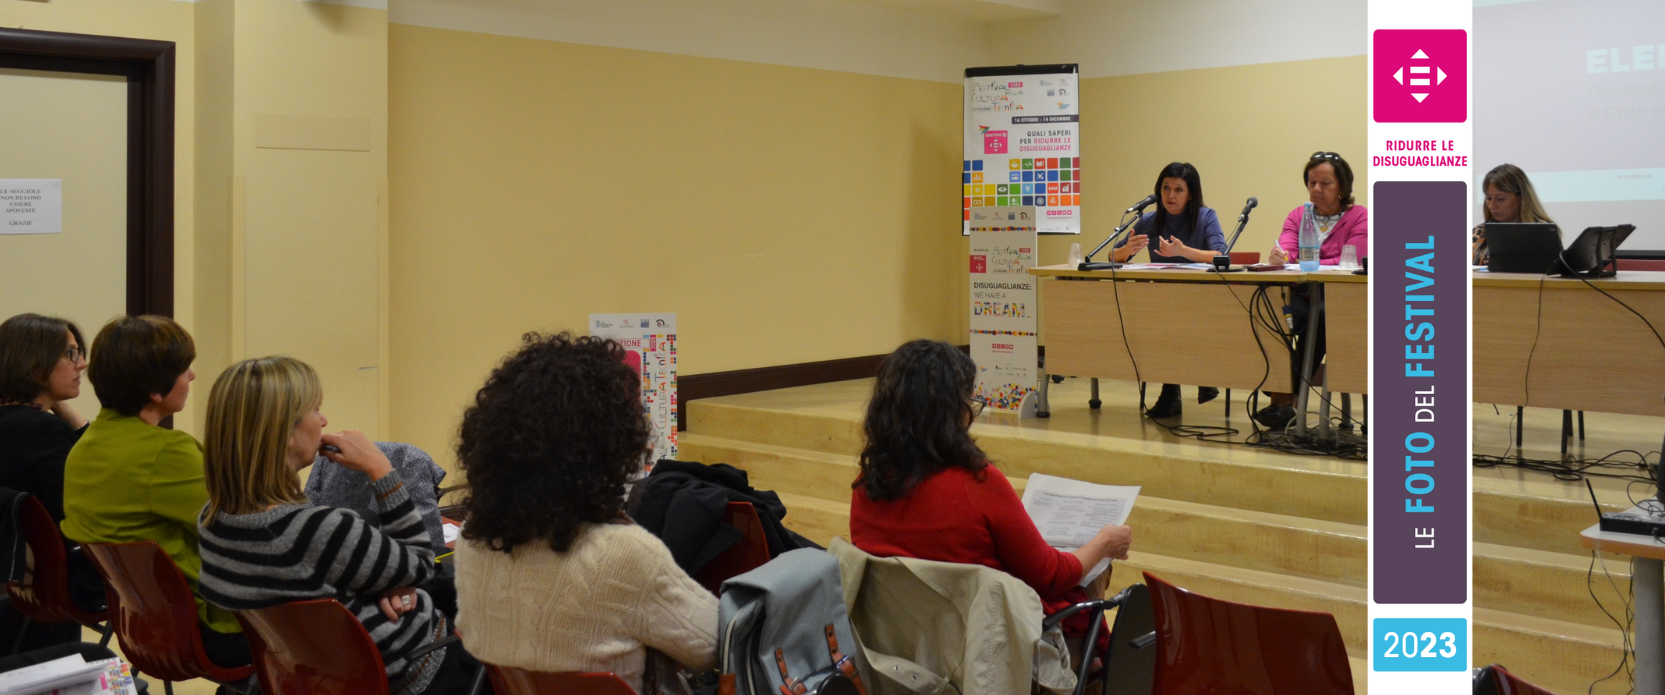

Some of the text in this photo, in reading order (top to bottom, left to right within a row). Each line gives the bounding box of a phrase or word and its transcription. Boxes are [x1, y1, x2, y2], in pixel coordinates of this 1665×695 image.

[1019, 144, 1071, 152] DISUGUAGLIANZE
[973, 282, 1032, 291] DISUGUAGLIANZE:
[653, 342, 667, 383] TECNICA
[655, 382, 667, 429] CULTURA
